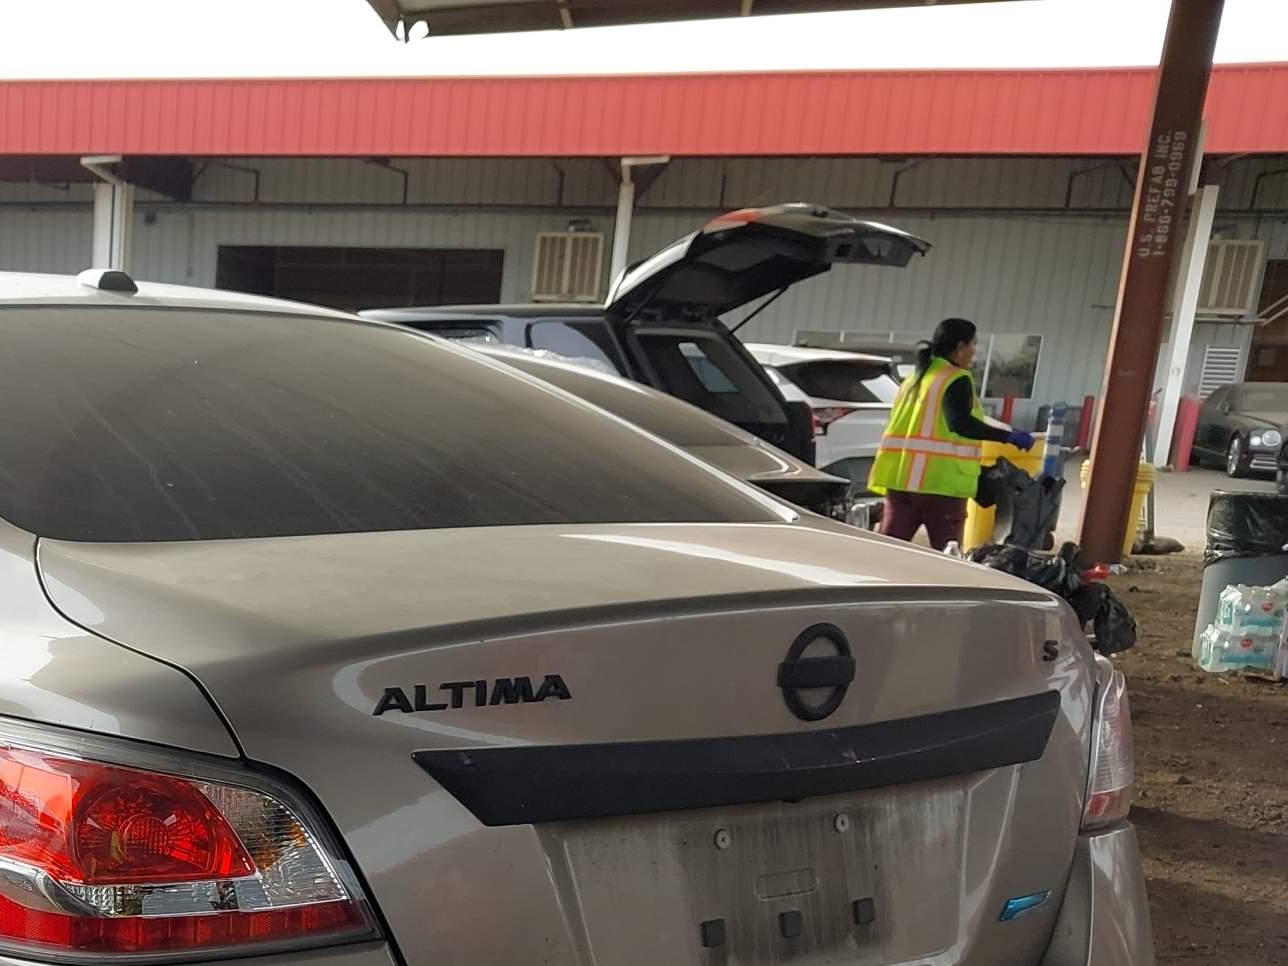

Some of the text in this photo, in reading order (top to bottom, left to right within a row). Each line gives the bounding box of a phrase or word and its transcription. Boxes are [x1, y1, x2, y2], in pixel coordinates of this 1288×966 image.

[1143, 166, 1165, 222] PREFAB
[1042, 640, 1059, 662] S
[372, 674, 571, 716] ALTIMA
